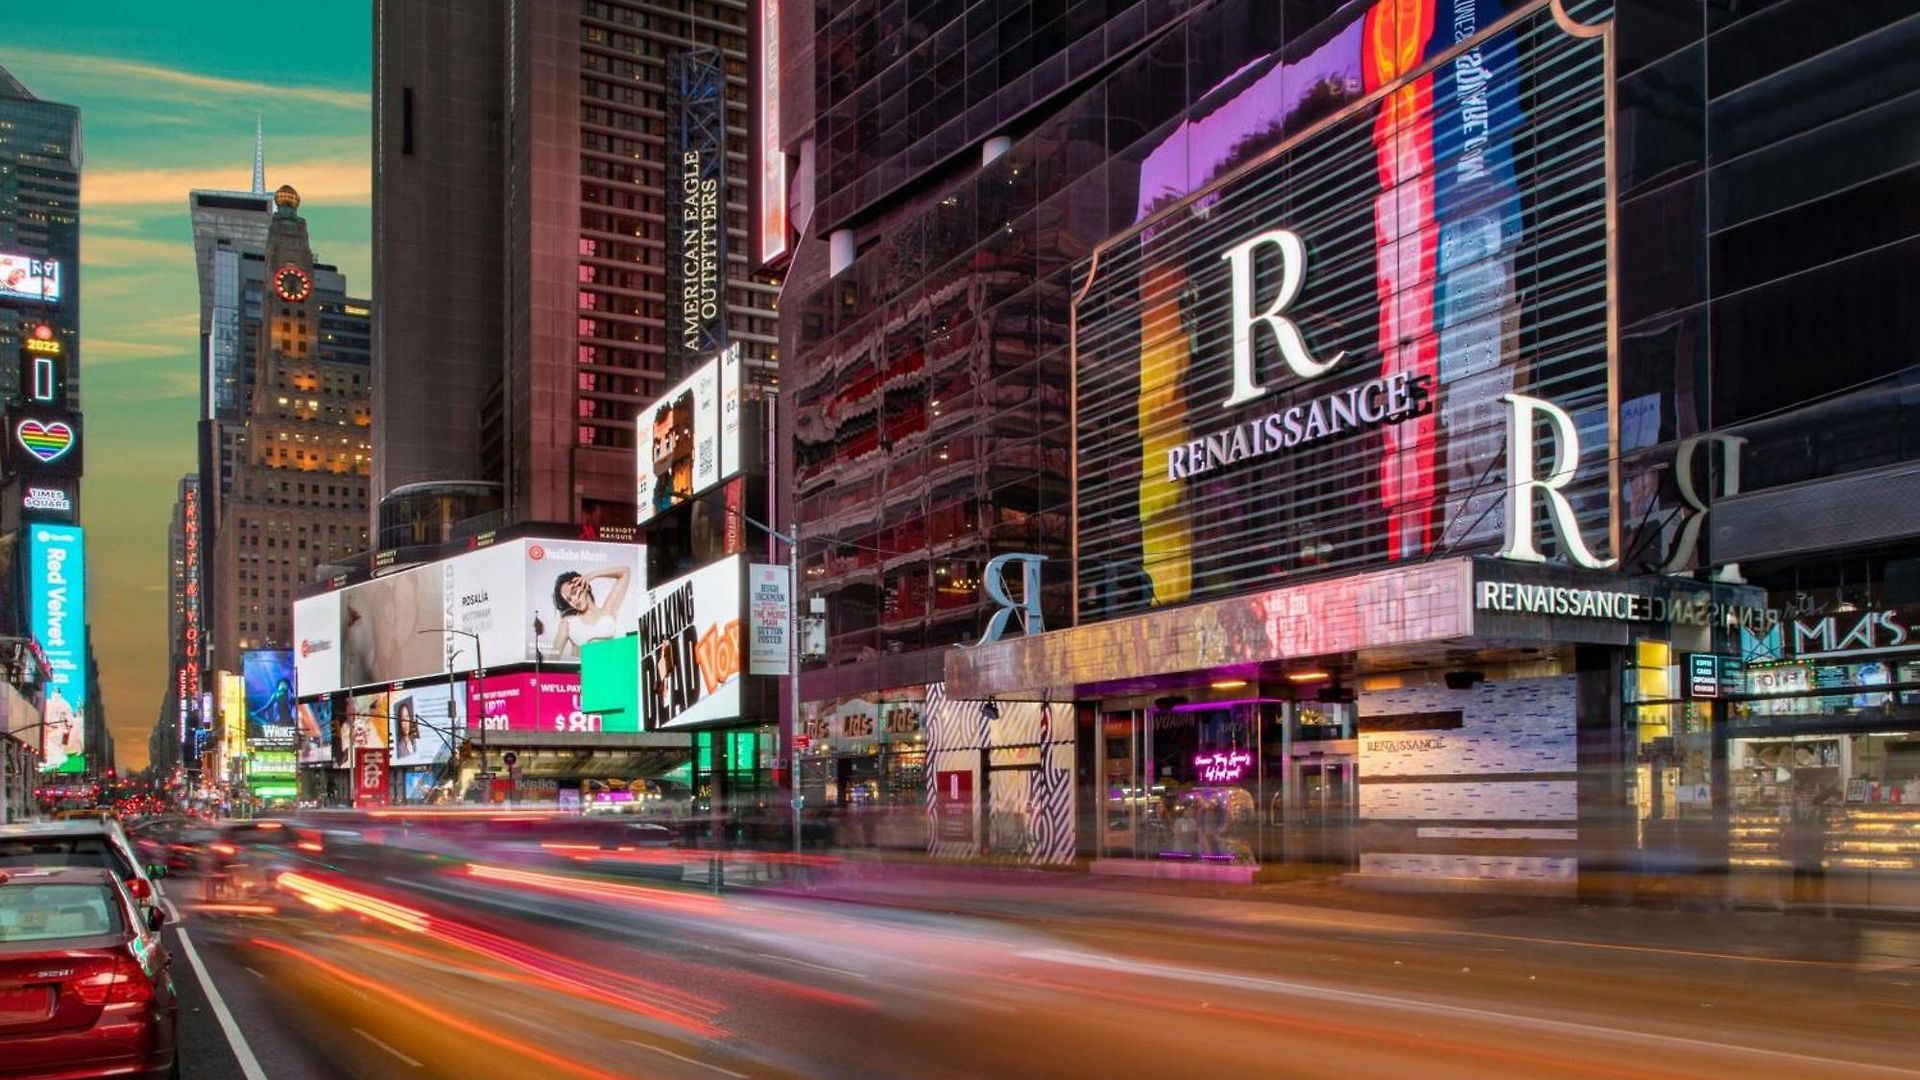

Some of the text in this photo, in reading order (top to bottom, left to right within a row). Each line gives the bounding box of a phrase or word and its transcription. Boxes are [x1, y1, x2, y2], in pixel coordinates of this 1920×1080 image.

[684, 149, 700, 352] AMERICAN EAGLE
[701, 179, 717, 319] OUTFITTERS
[1221, 229, 1345, 408] R
[28, 339, 60, 352] 2022
[1168, 370, 1412, 482] RENAISSANCE
[29, 488, 65, 500] TIMES
[1497, 393, 1618, 570] R
[24, 498, 70, 510] SQUARE
[600, 526, 636, 534] MARRIOTT
[600, 533, 633, 541] MARQUIS
[47, 548, 66, 584] Red
[47, 587, 66, 646] Velvet
[638, 579, 695, 657] WALKING
[1477, 580, 1640, 620] RENAISSANCE
[541, 684, 582, 693] WE'LL PAY
[640, 624, 701, 730] DEAD
[842, 713, 873, 737] Lids
[885, 708, 920, 733] Lids
[1366, 739, 1445, 752] RENAISSANCE
[363, 751, 383, 788] tkts
